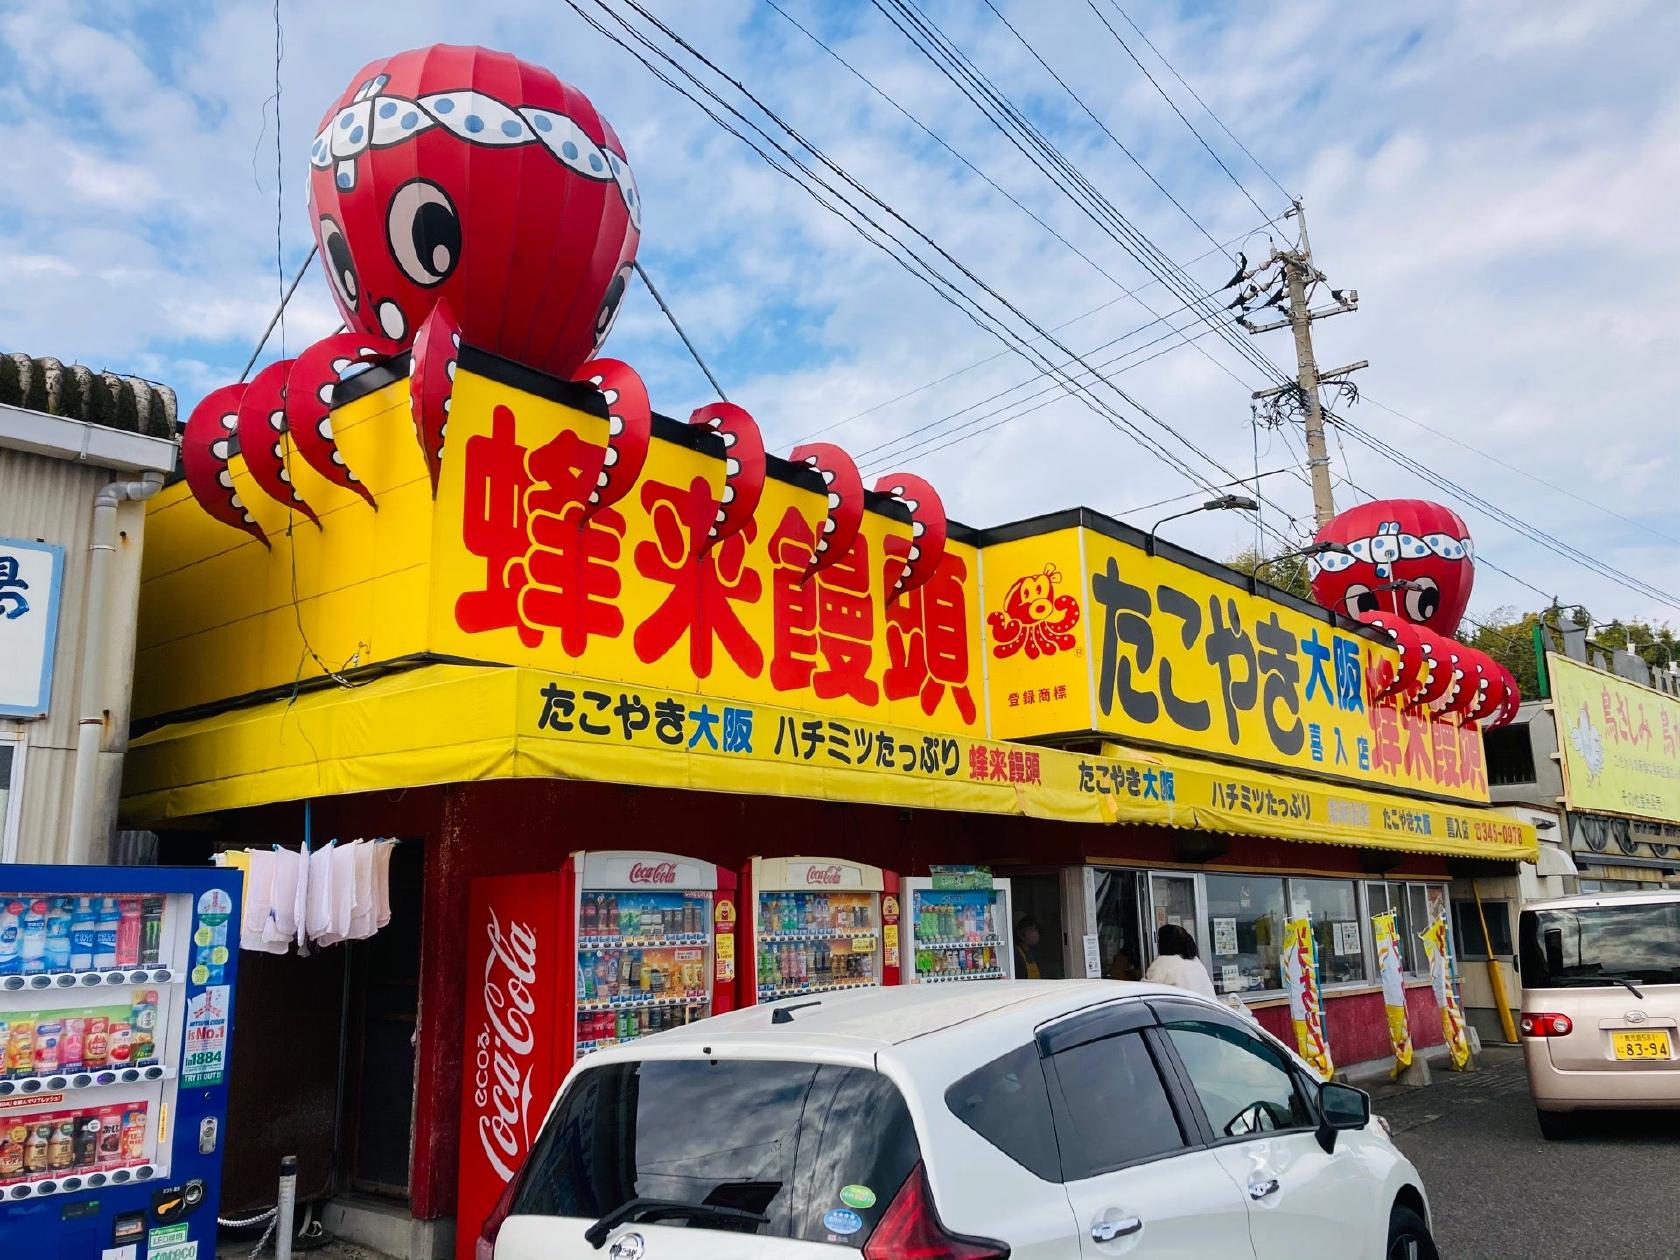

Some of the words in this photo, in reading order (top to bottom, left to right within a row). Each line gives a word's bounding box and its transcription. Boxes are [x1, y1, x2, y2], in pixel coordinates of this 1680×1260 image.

[455, 404, 977, 725] 蜂来饅頭
[1008, 685, 1067, 707] 登録商標
[774, 719, 960, 776] ハチミツたっぷり
[969, 744, 1042, 785] 蜂来饅頭
[1308, 722, 1369, 771] 喜入店
[1212, 781, 1310, 820] ハチミツたっぷり
[1446, 816, 1469, 841] 喜入店
[191, 1050, 222, 1066] 1884
[197, 1025, 225, 1040] No.1
[479, 905, 537, 1183] Coca-Cola
